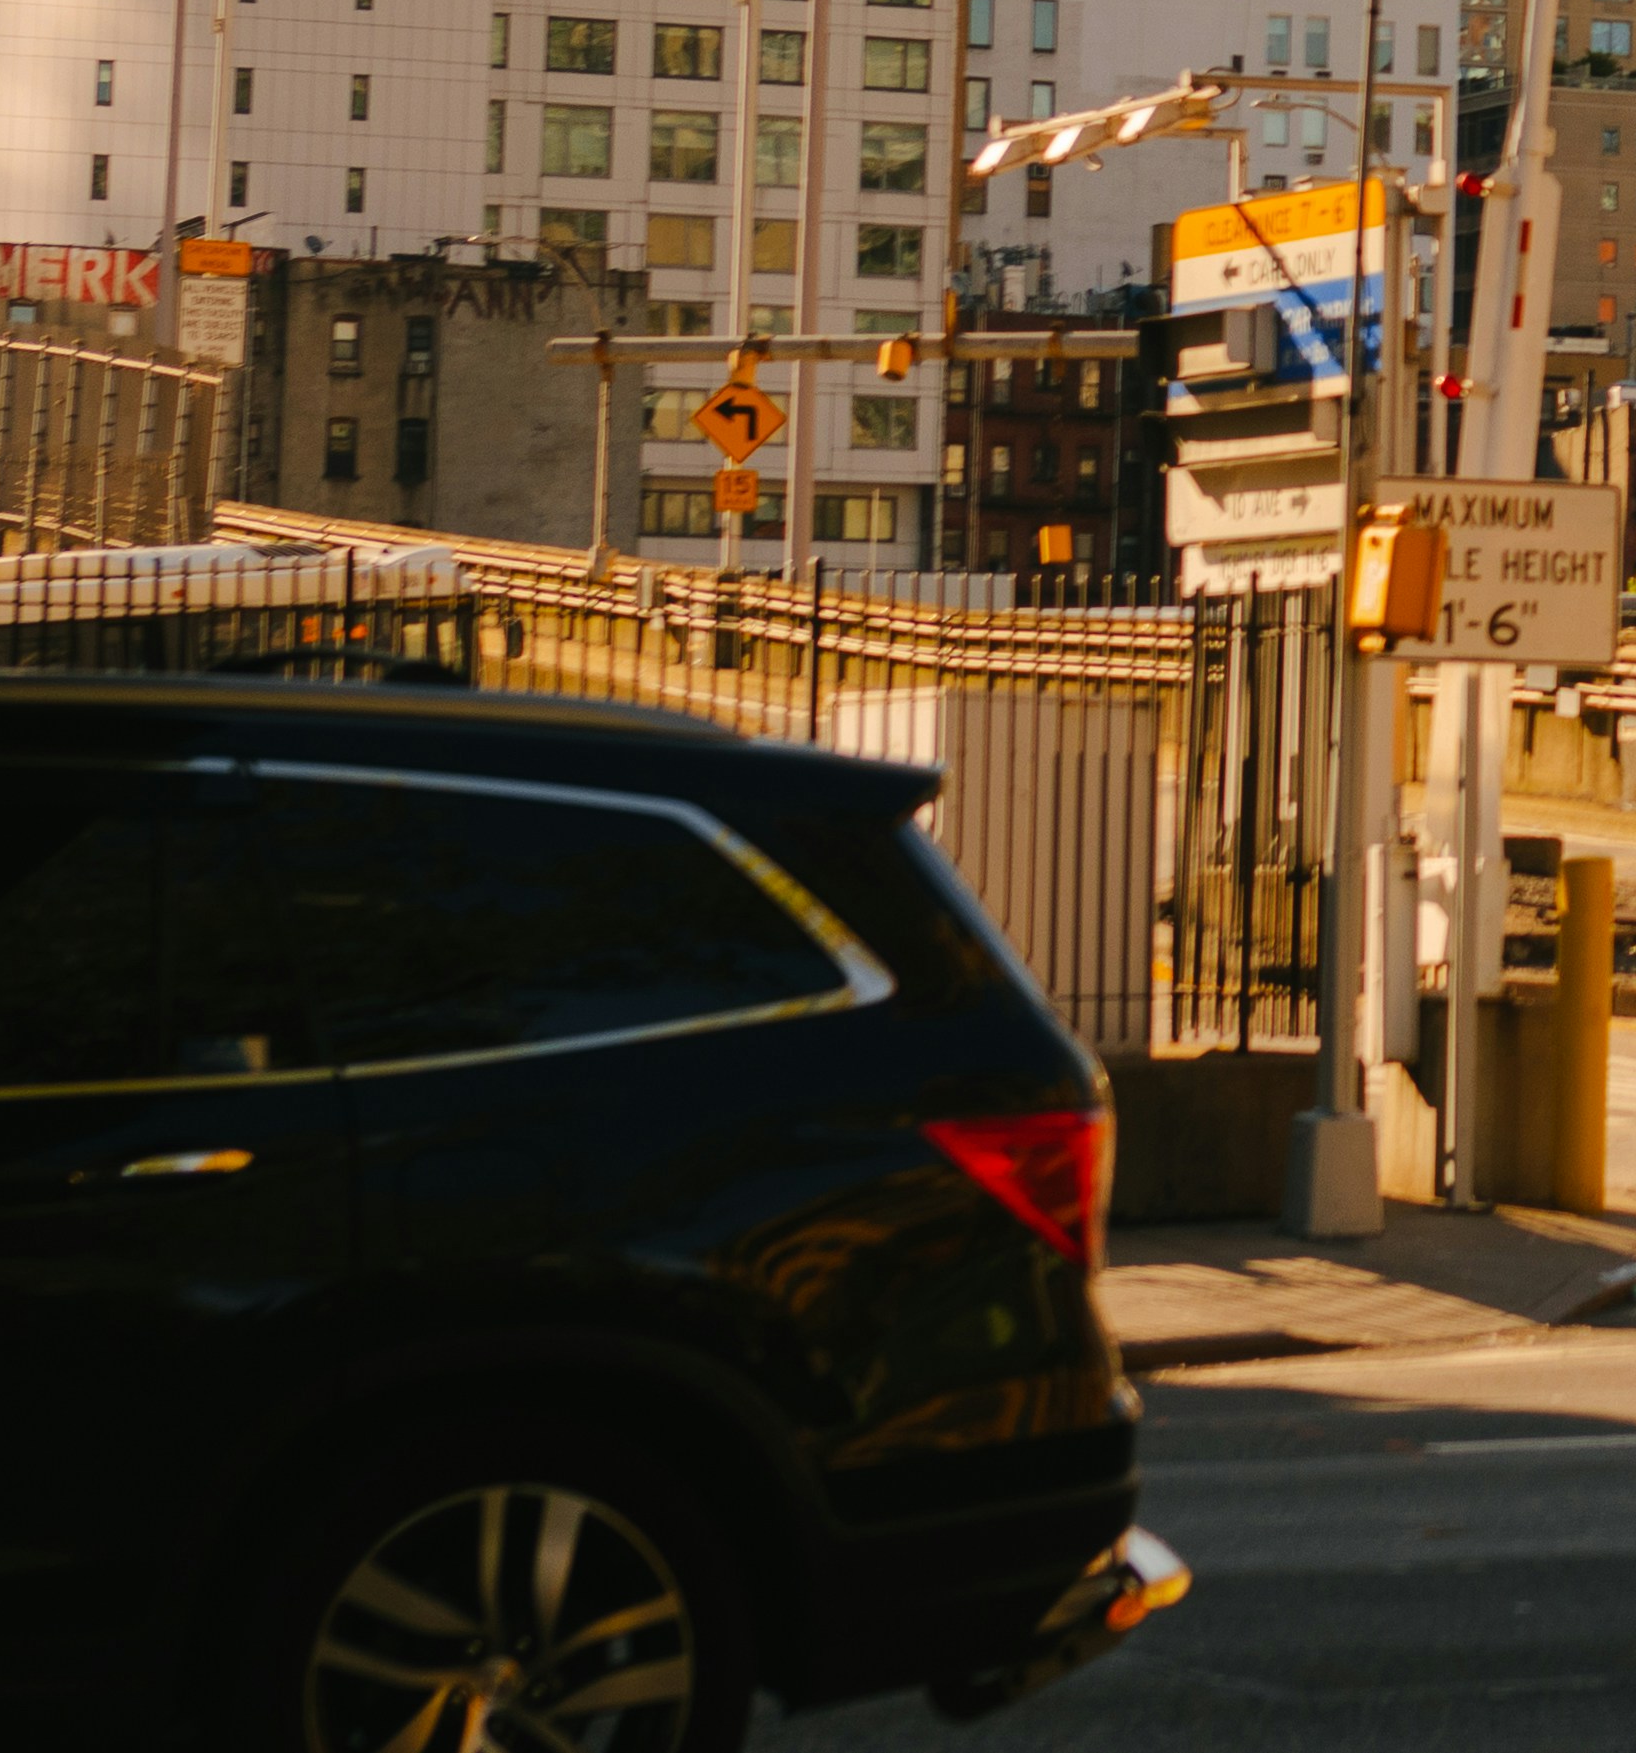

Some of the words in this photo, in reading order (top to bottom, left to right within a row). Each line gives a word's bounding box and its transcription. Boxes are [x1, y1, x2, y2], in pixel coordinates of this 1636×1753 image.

[724, 476, 749, 493] 15
[1414, 493, 1555, 530] MAXIMUM
[1501, 549, 1607, 585] HEIGHT
[1442, 599, 1540, 646] 1'-6"
